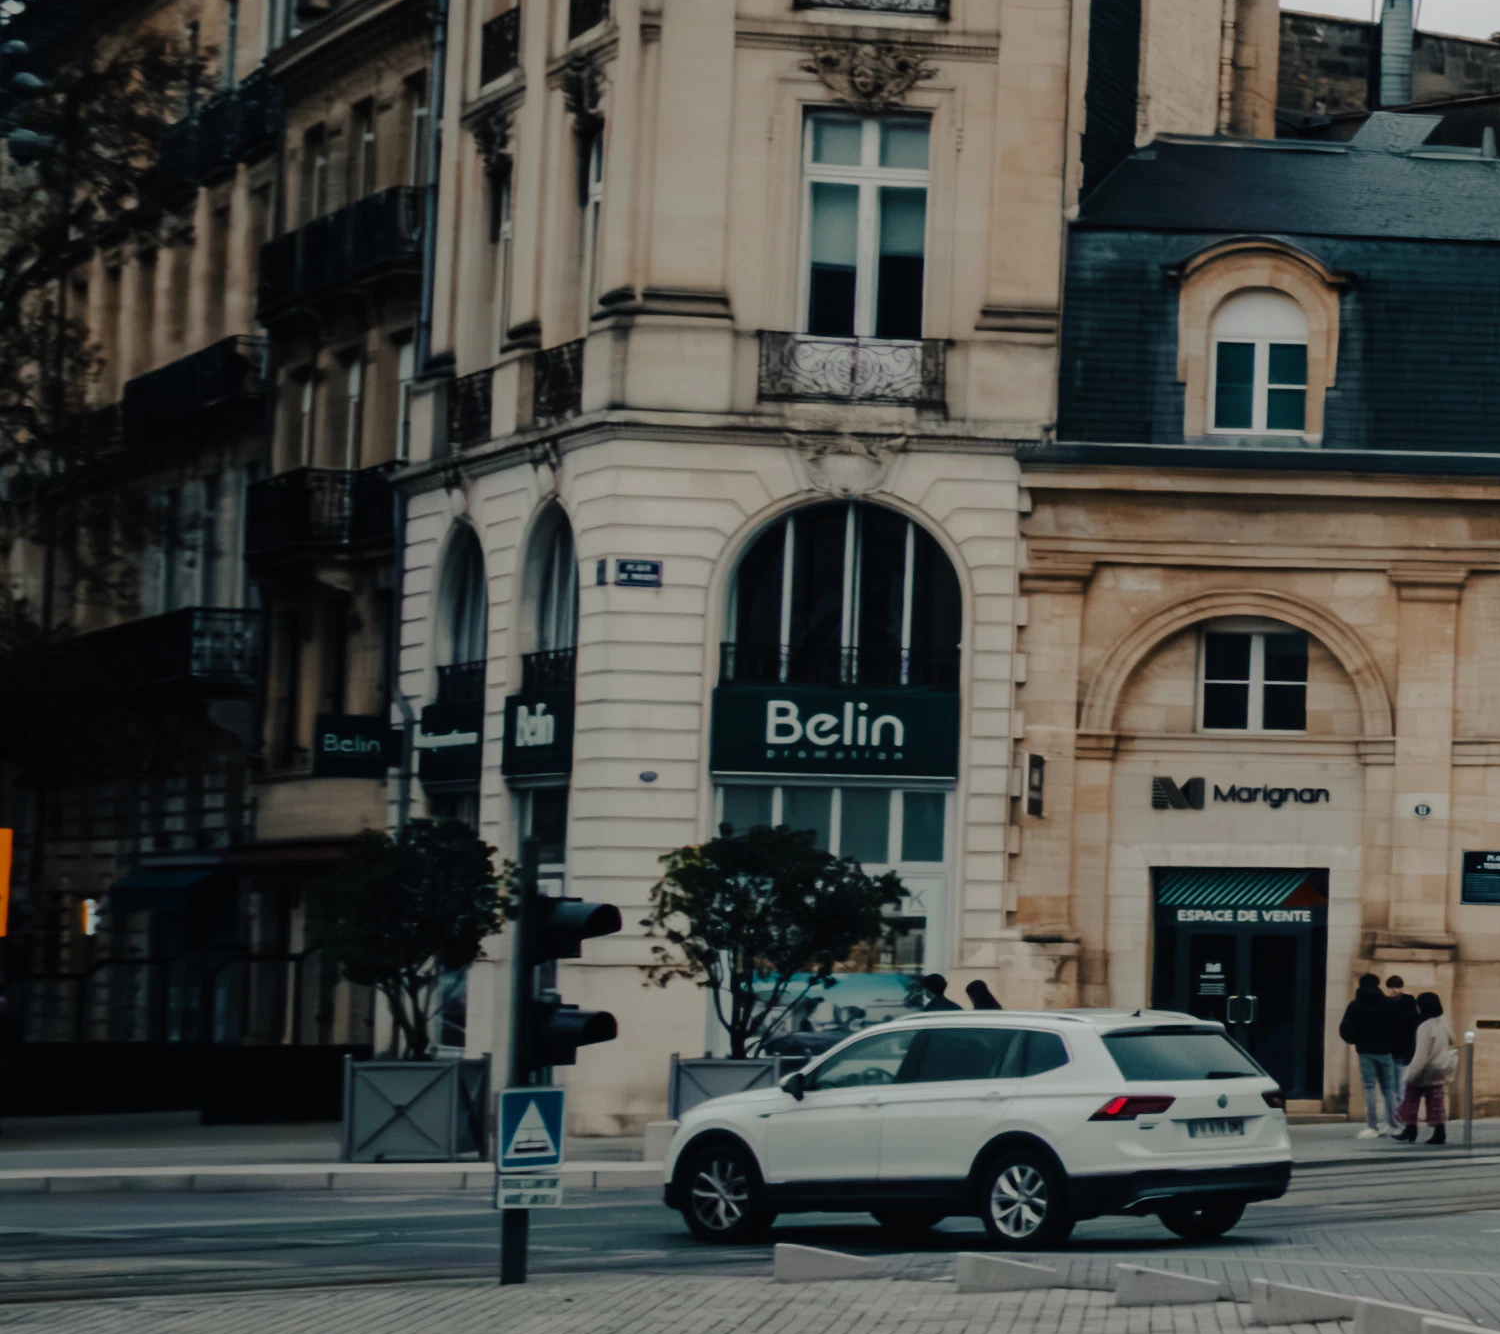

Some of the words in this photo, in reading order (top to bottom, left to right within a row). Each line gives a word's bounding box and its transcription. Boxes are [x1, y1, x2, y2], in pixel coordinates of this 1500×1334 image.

[766, 699, 905, 747] Belin
[322, 733, 382, 754] Belin
[1213, 784, 1330, 809] Marignan
[1177, 909, 1234, 922] ESPACE
[1237, 909, 1259, 922] DE
[1262, 910, 1313, 923] VENTE
